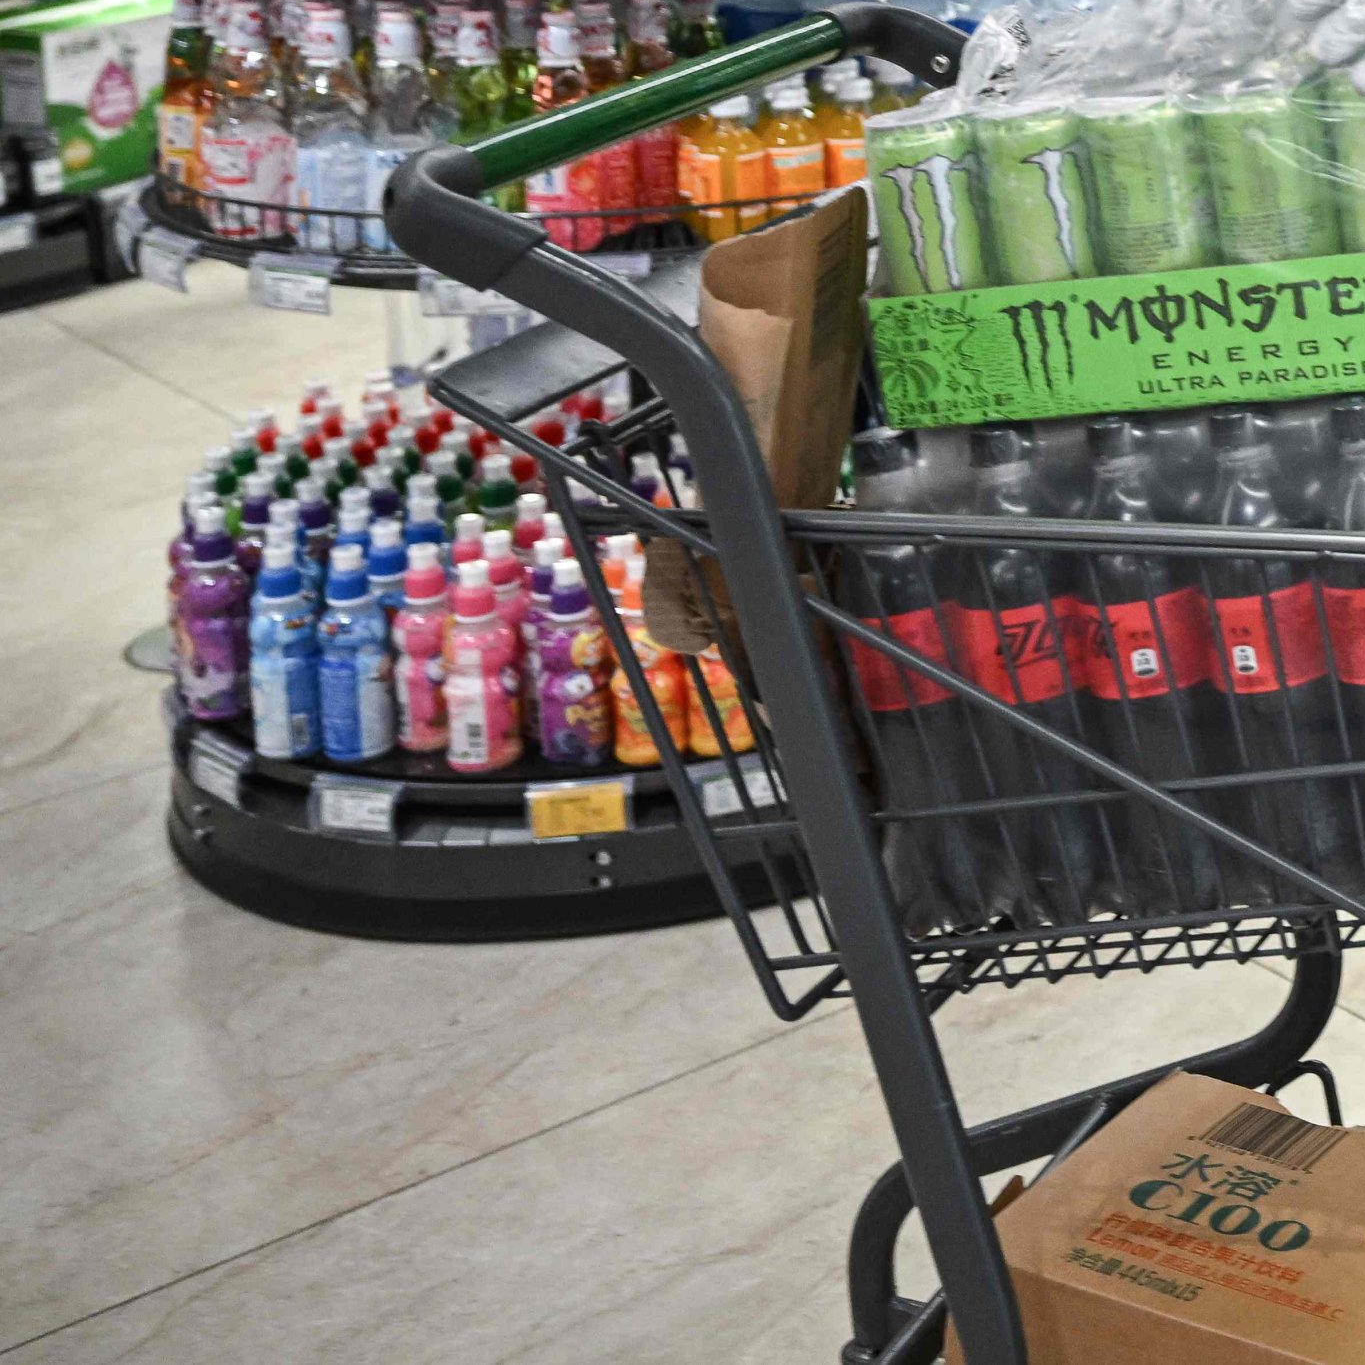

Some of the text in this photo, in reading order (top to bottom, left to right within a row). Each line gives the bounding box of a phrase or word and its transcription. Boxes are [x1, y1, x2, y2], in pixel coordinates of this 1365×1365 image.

[1152, 335, 1355, 370] ENERGY
[1137, 374, 1225, 395] ULTRA
[1160, 1152, 1282, 1202] 水溶
[1128, 1179, 1312, 1252] C100
[1086, 1227, 1159, 1261] Lemon
